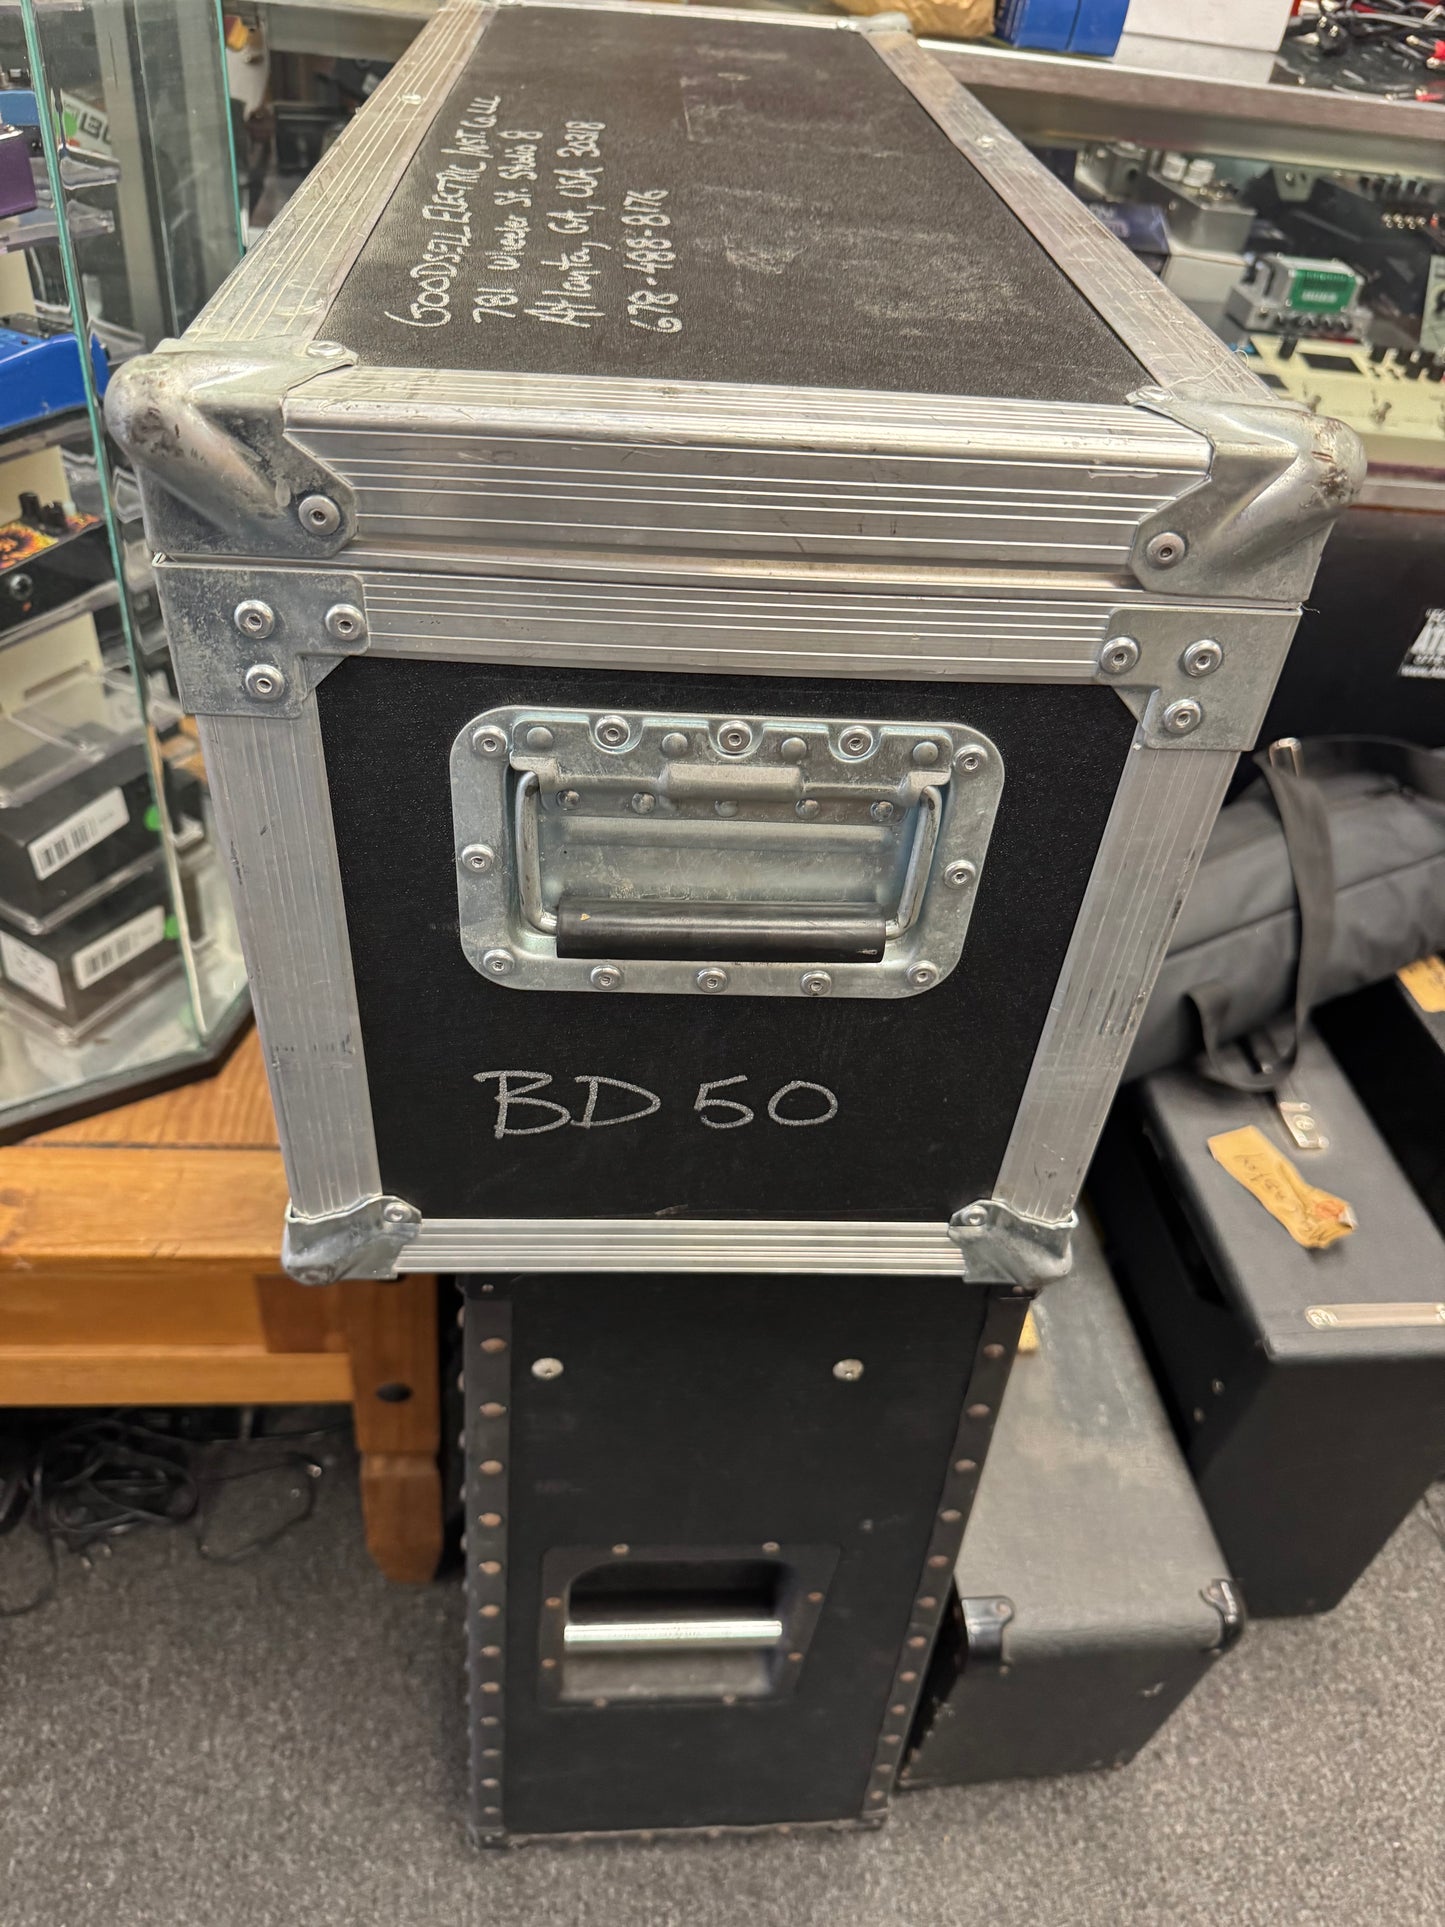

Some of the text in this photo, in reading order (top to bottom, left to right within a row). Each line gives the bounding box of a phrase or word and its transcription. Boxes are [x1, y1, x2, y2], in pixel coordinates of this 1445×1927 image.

[556, 120, 606, 158] 30318
[421, 162, 487, 224] ELECTRIC
[552, 167, 604, 198] USA
[472, 287, 519, 324] 781
[497, 129, 544, 140] 8
[472, 1070, 839, 1140] BD 50
